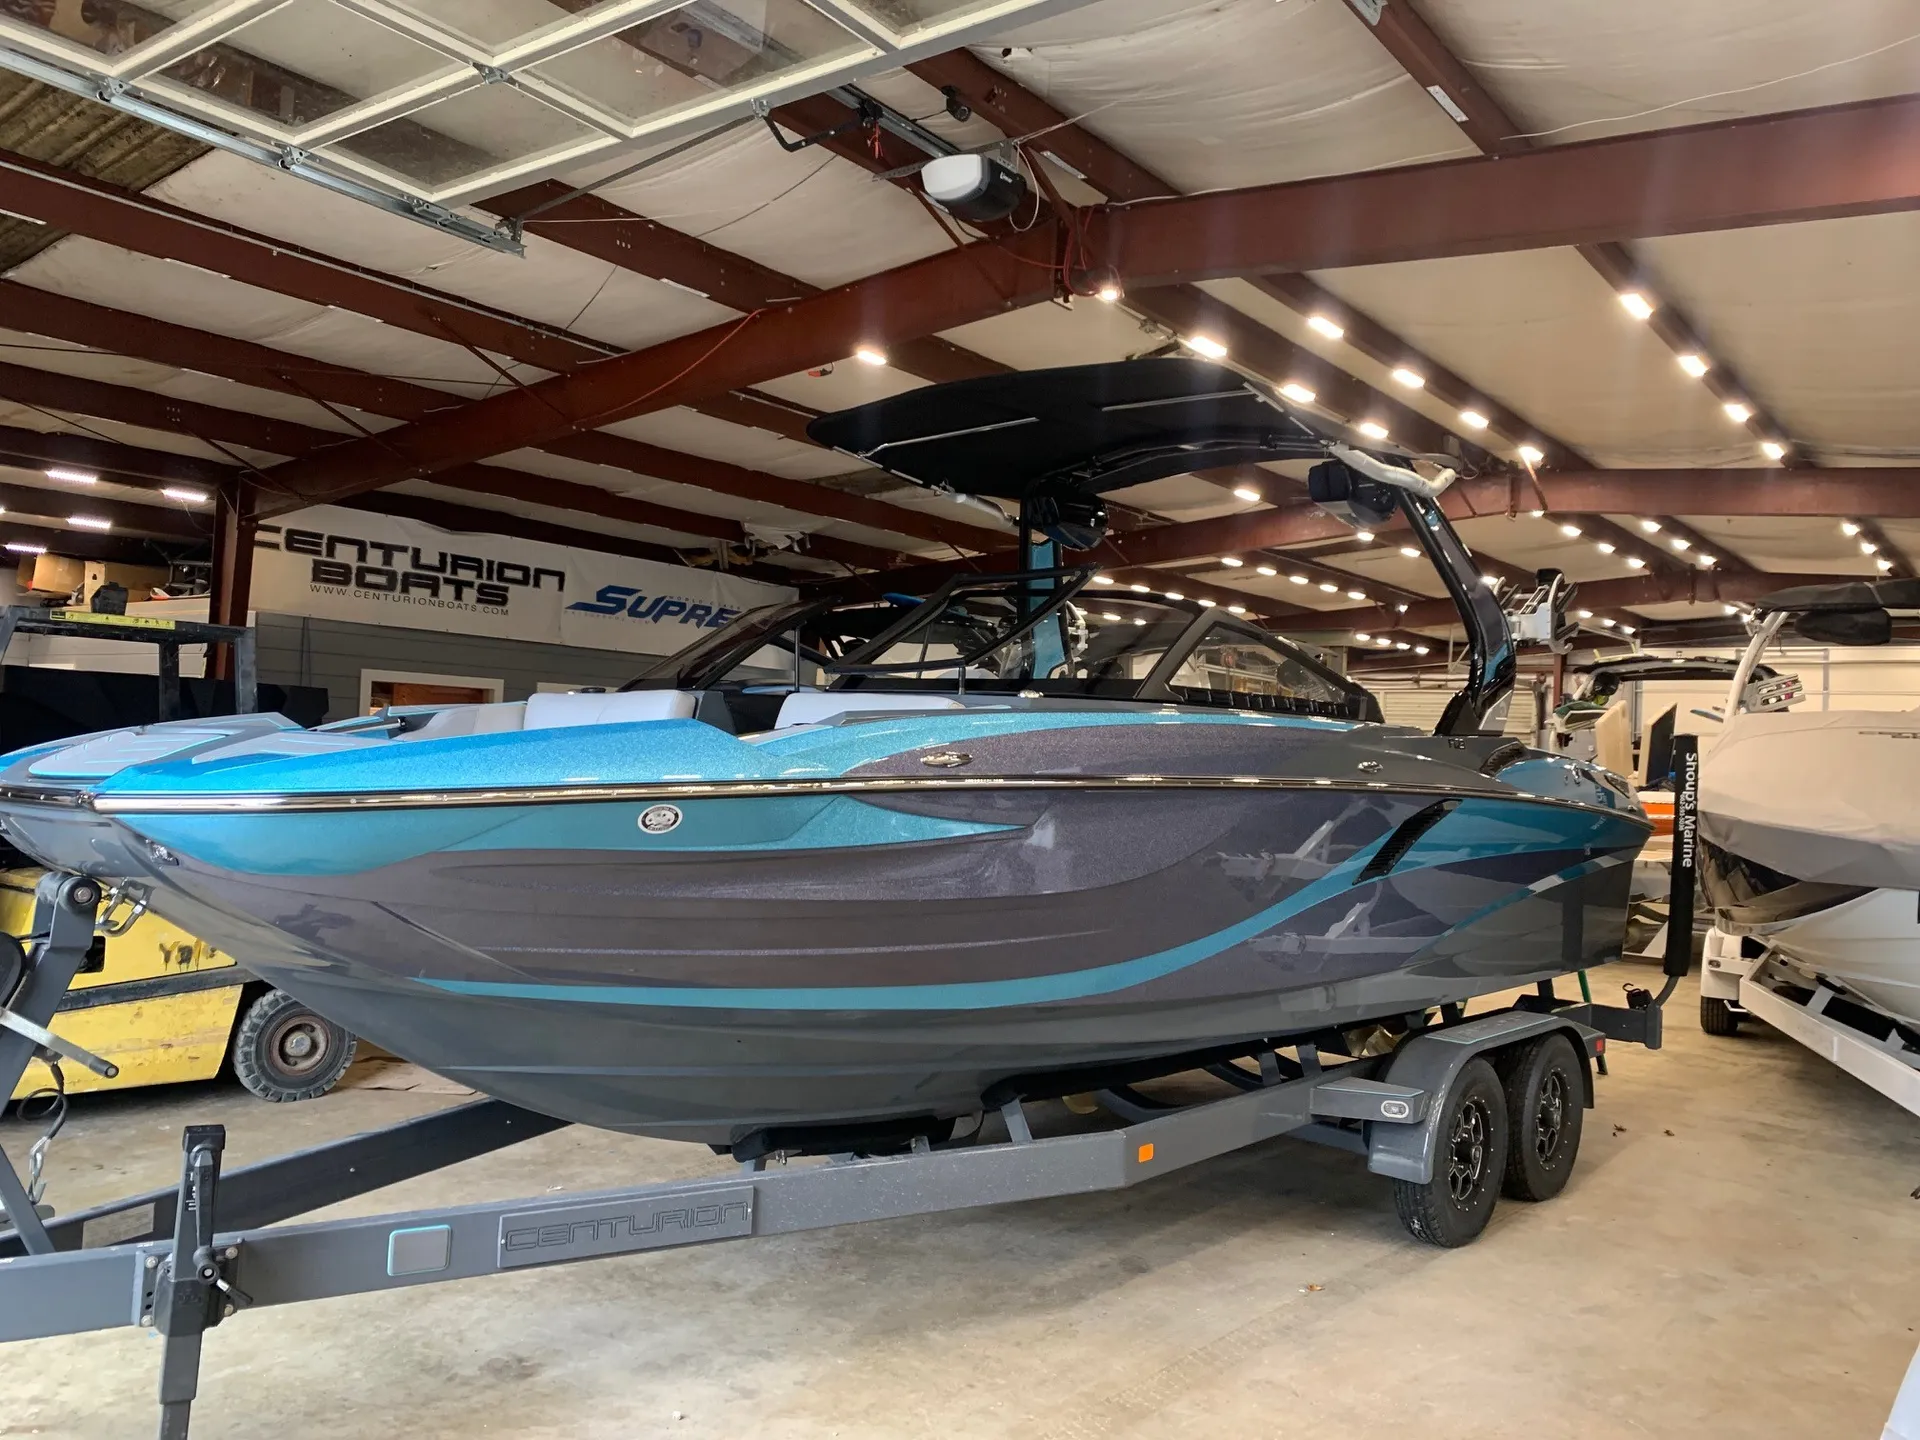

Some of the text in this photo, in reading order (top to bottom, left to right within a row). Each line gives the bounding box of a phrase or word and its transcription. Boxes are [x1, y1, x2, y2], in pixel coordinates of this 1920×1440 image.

[309, 583, 509, 616] WWW.CENTURIONBOATS.COM
[311, 558, 510, 607] BOATS
[1682, 752, 1698, 868] Shoup's Marine
[505, 1201, 749, 1252] CENTURION
